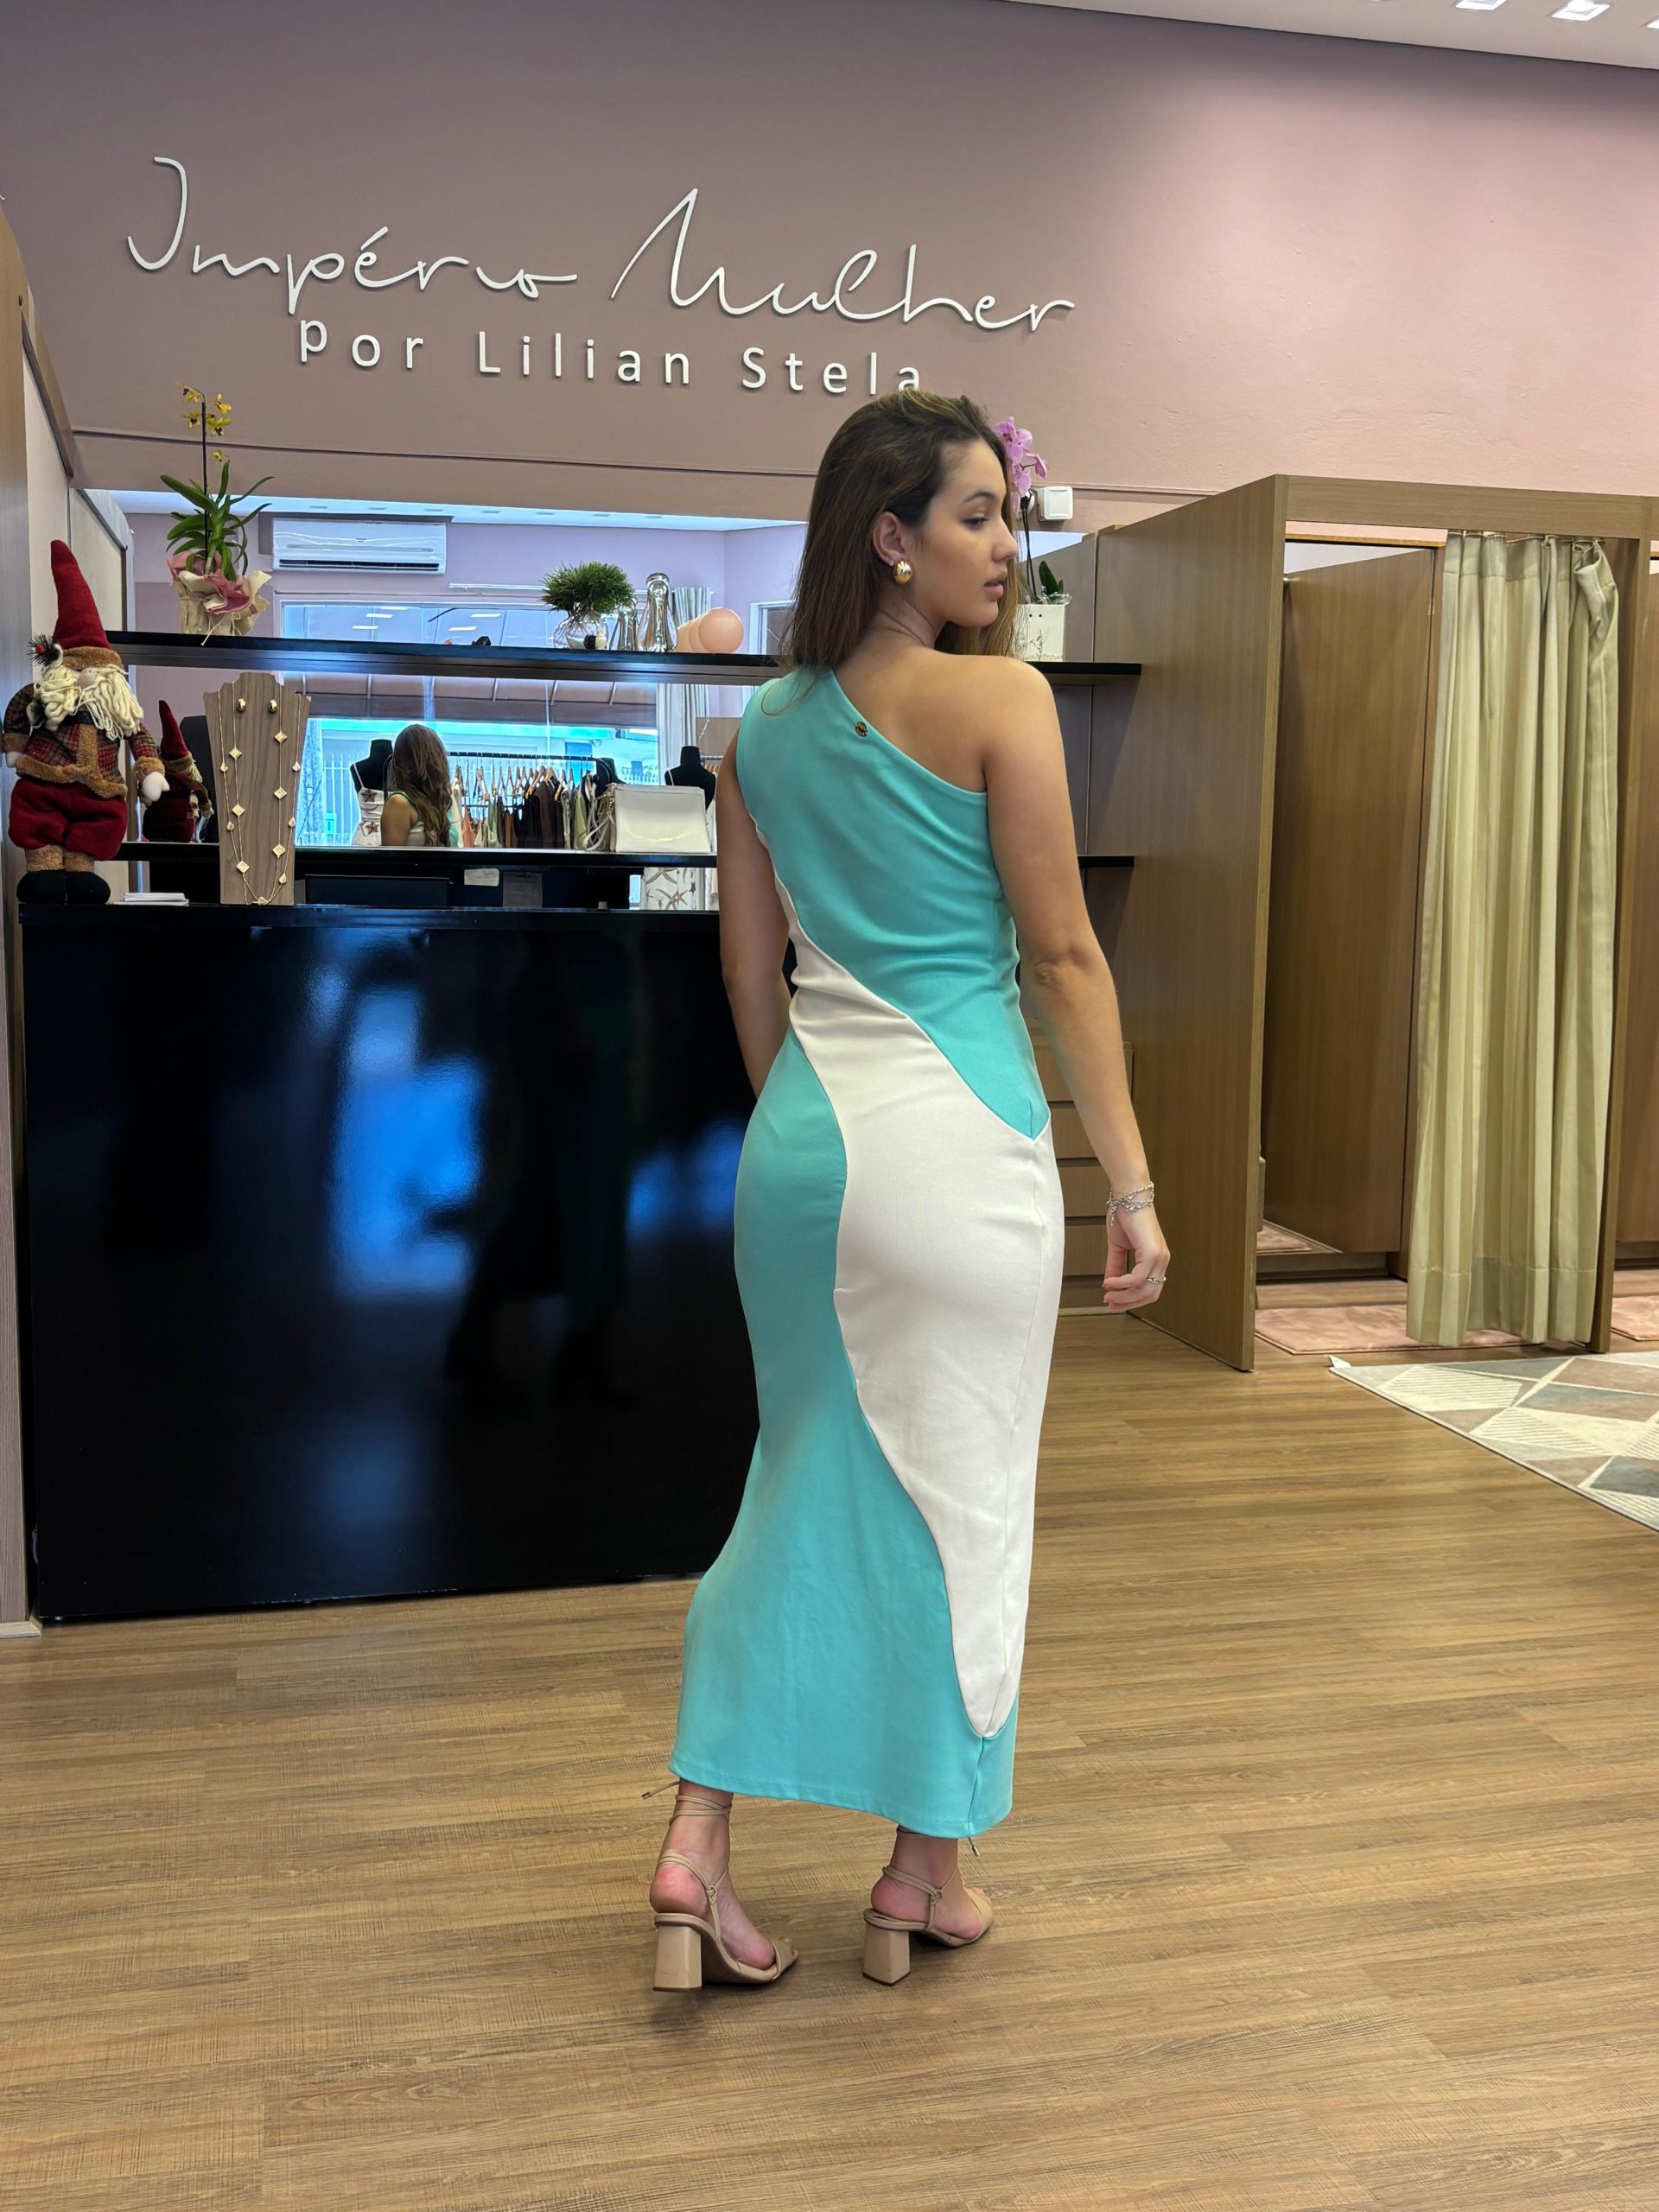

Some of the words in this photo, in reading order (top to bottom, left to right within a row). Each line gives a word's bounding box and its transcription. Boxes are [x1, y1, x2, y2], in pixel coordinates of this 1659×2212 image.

[127, 156, 578, 315] Império
[611, 188, 1076, 332] Mulher
[300, 319, 424, 368] por
[479, 330, 690, 384] Lilian
[741, 346, 920, 395] Stela
